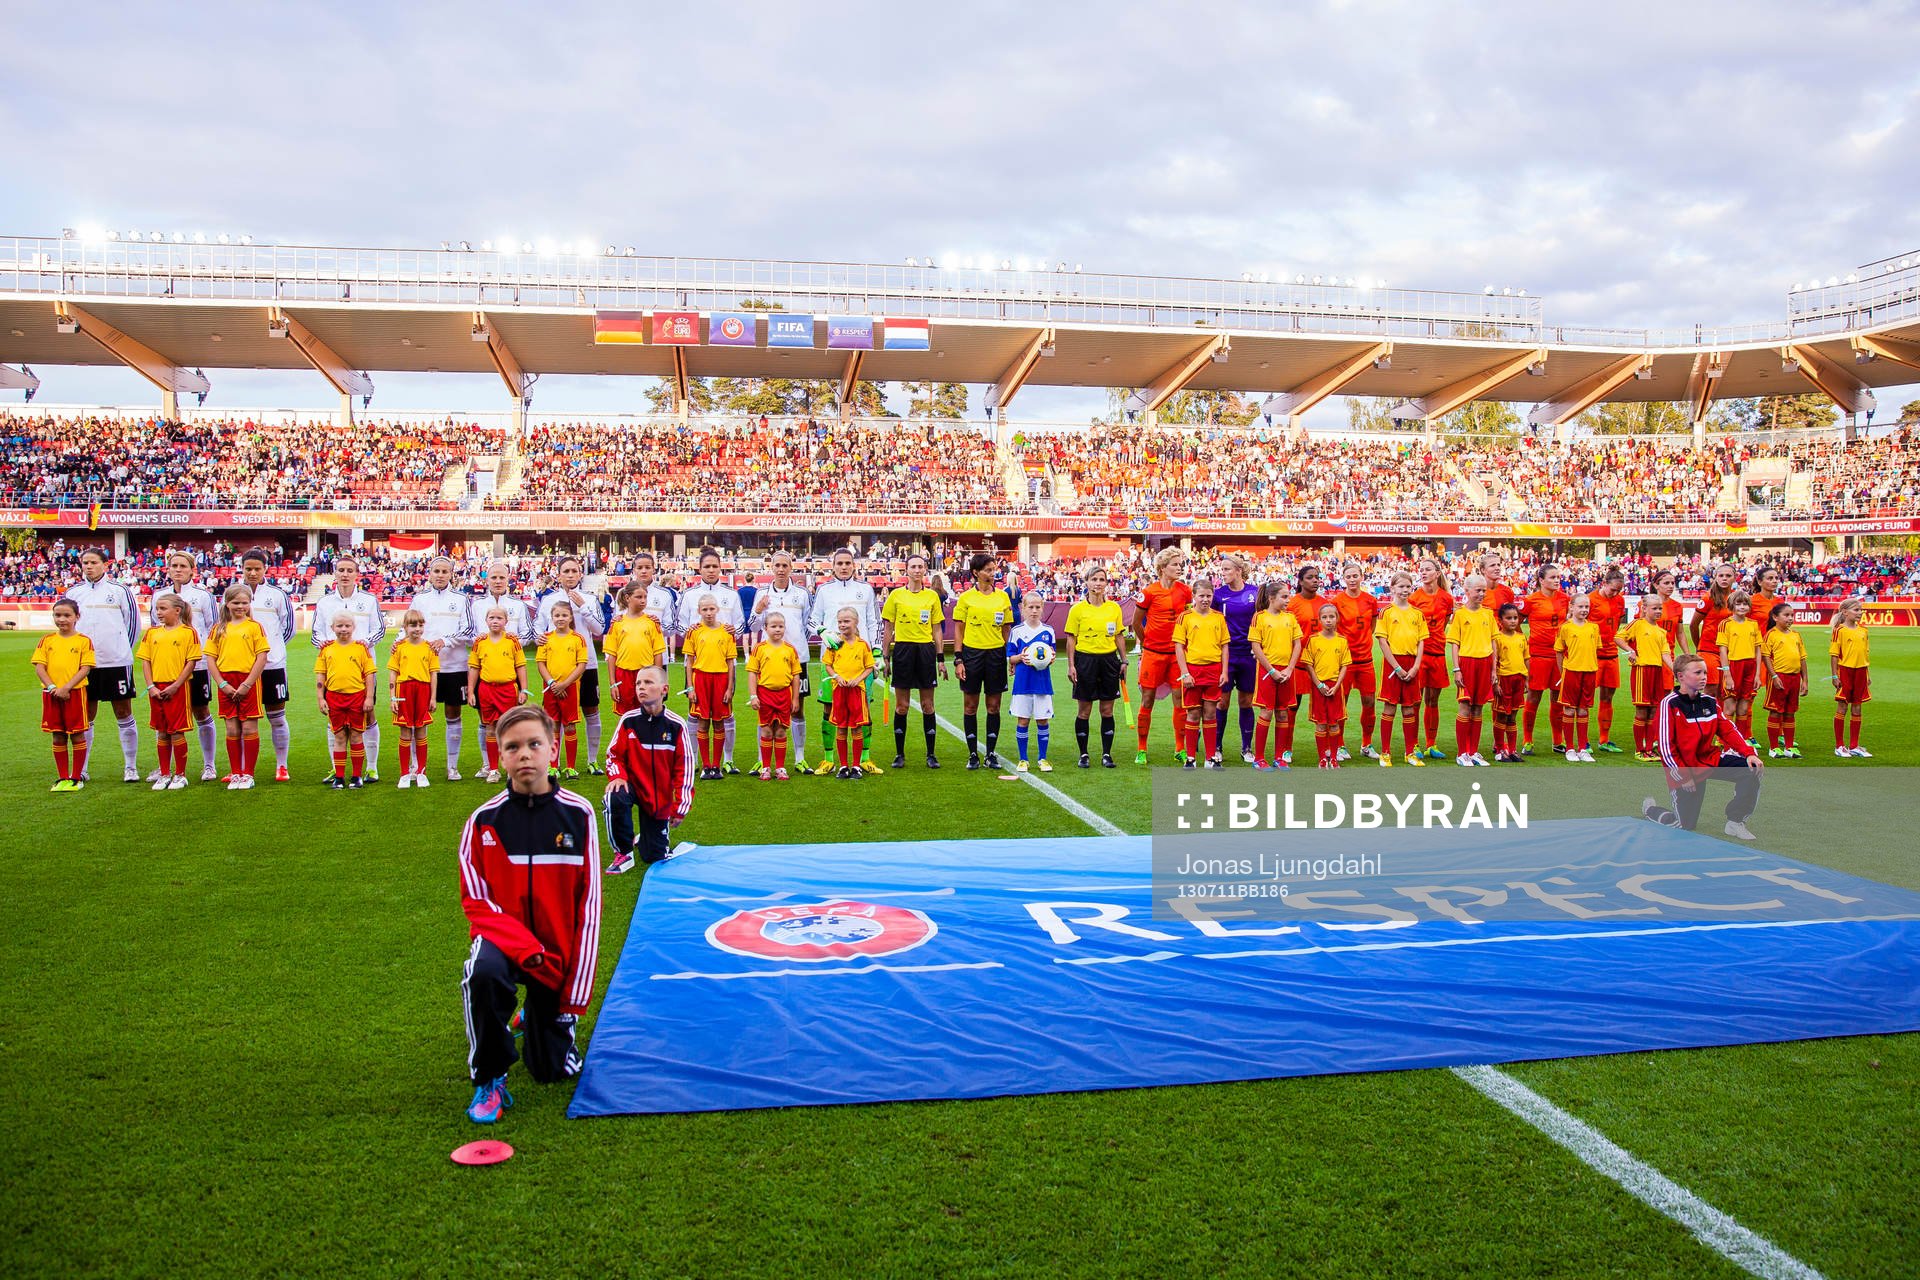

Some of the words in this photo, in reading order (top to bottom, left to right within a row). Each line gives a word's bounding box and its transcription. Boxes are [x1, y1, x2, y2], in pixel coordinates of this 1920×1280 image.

[777, 322, 805, 332] FIFA
[109, 514, 158, 523] WOMEN'S
[160, 514, 190, 523] EURO
[425, 516, 452, 525] UEFA
[453, 516, 500, 525] WOMEN'S
[502, 516, 530, 525] EURO
[826, 517, 851, 527] EURO
[996, 518, 1026, 529] VÄXJÖ
[1061, 520, 1086, 529] UEFA
[1286, 522, 1315, 531] VÄXJÖ
[1345, 524, 1367, 532] UEFA
[1368, 524, 1405, 533] WOMEN'S
[1406, 525, 1429, 533] EURO
[1548, 525, 1574, 535] VÄXJÖ
[1781, 525, 1808, 533] EURO
[1812, 524, 1838, 533] UEFA
[1838, 523, 1883, 532] WOMEN'S
[1884, 521, 1911, 531] EURO
[1613, 526, 1639, 535] UEFA
[1639, 526, 1680, 535] WOMEN'S
[1681, 526, 1706, 535] EURO
[1795, 611, 1822, 623] EURO
[1857, 610, 1895, 625] ÄXJÖ
[1356, 616, 1364, 630] 5
[1662, 619, 1673, 632] 10
[118, 680, 127, 695] 5
[799, 678, 808, 692] 20
[203, 685, 209, 699] 3
[275, 683, 286, 699] 10
[1022, 866, 1864, 944] RESPECT
[752, 905, 878, 920] UEFA
